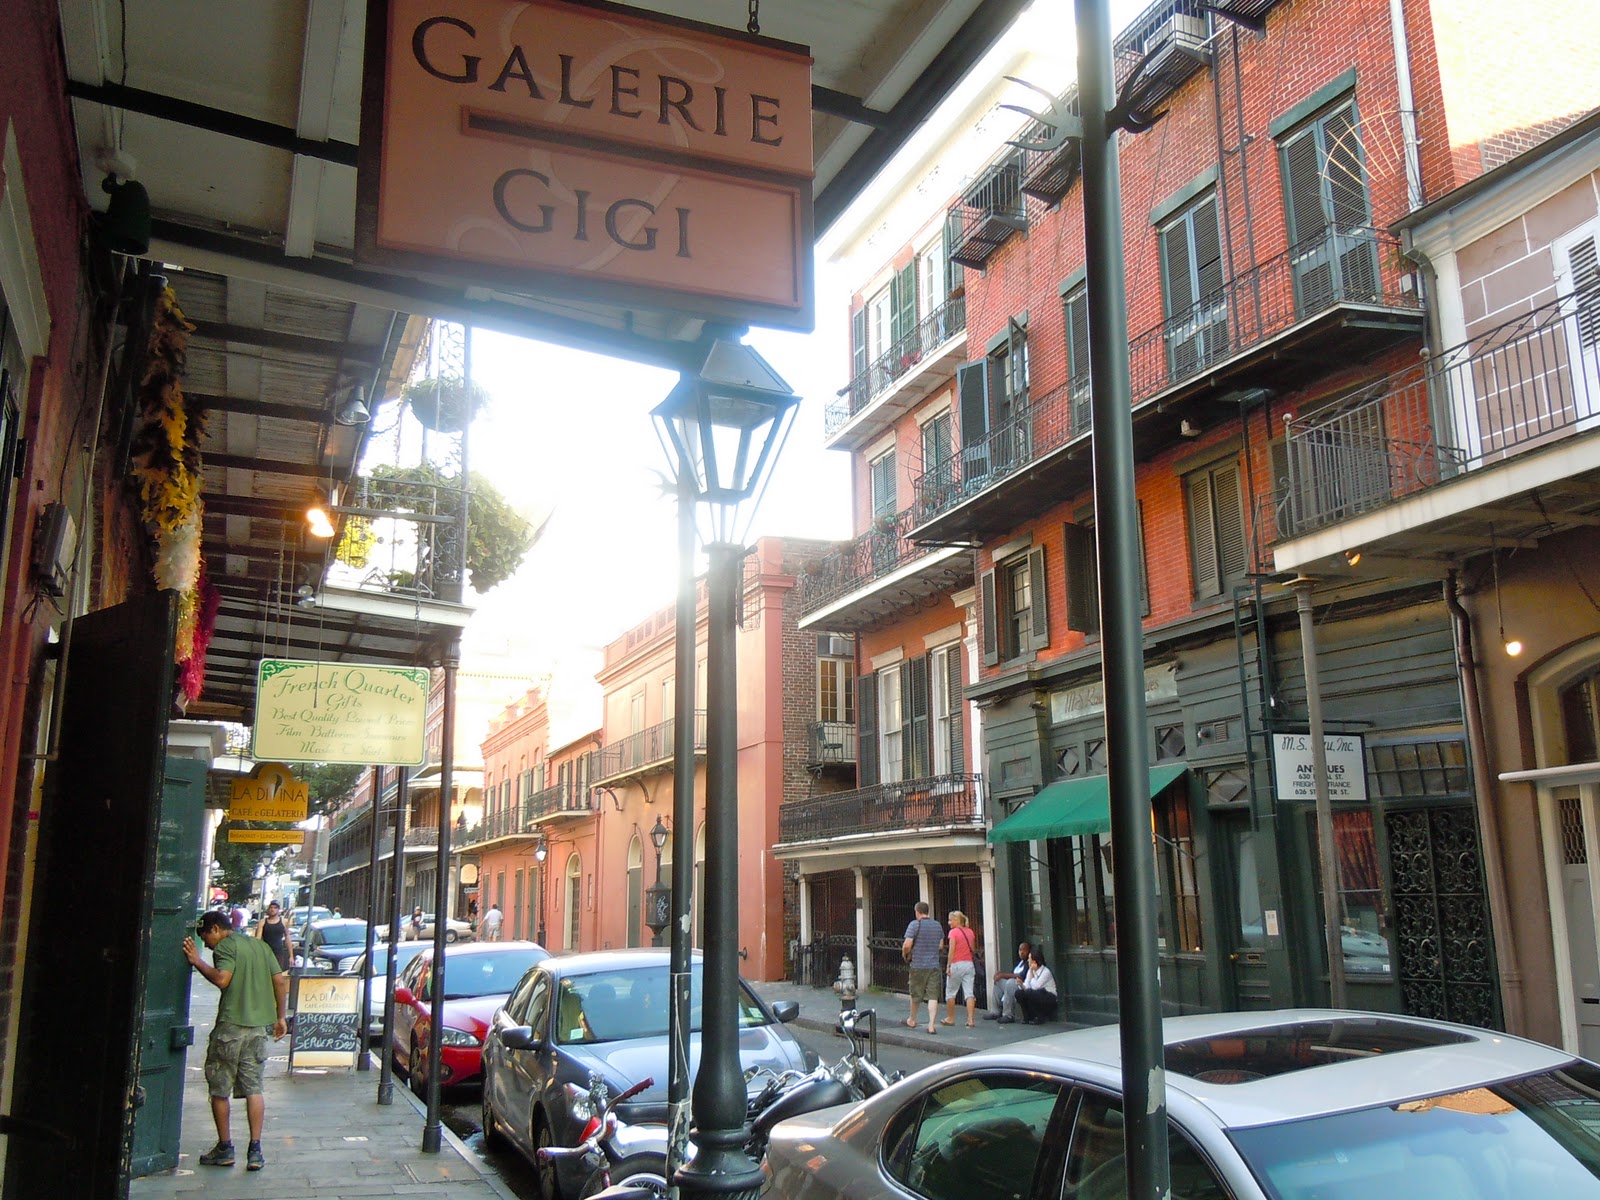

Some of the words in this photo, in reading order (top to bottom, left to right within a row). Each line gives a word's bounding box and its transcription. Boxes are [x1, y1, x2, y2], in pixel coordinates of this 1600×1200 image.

[411, 16, 783, 147] GALERIE
[492, 168, 690, 258] GIGI
[273, 671, 339, 698] French
[344, 669, 415, 704] Quarter
[326, 693, 362, 711] Gifts
[272, 707, 297, 720] Best
[300, 709, 339, 725] Quality
[275, 723, 302, 737] Film
[1337, 738, 1354, 752] Inc.
[1296, 765, 1344, 773] ANUES
[232, 787, 252, 800] LA
[257, 781, 306, 802] DIVINA
[260, 809, 304, 818] GELATERIA
[304, 993, 318, 1002] LA
[296, 1013, 358, 1025] BREAKFAST
[339, 1032, 356, 1040] ALL
[334, 1039, 356, 1050] DAY
